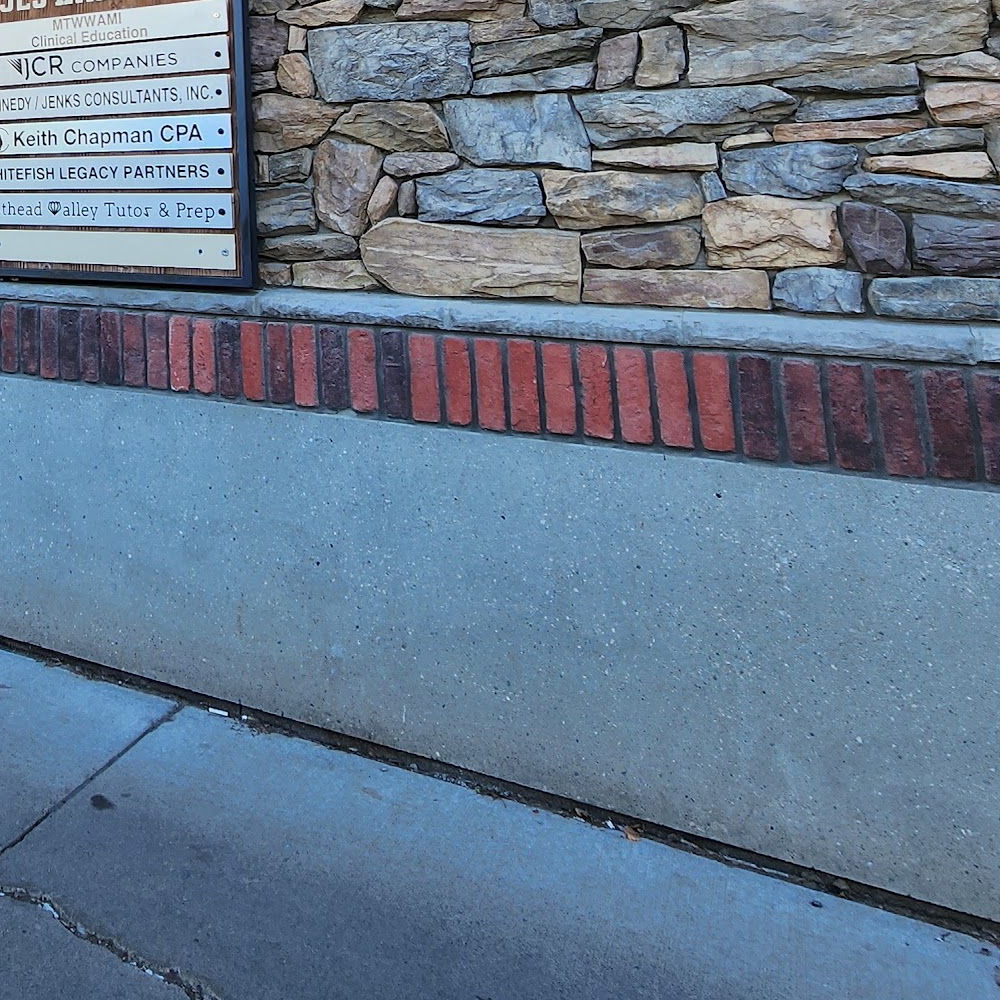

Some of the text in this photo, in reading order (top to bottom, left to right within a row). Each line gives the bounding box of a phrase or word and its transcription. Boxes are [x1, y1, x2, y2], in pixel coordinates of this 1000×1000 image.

[52, 12, 122, 31] MTWWAMI
[31, 27, 148, 48] Clinical Education
[24, 53, 178, 80] JCR COMPANIES
[41, 93, 81, 110] JENKS
[85, 86, 182, 107] CONSULTANTS,
[186, 85, 214, 101] INC.
[13, 124, 203, 149] Keith Chapman CPA
[60, 166, 118, 180] LEGACY
[123, 164, 210, 179] PARTNERS
[104, 202, 152, 218] Tutor
[158, 202, 170, 217] &
[176, 202, 215, 222] Prep
